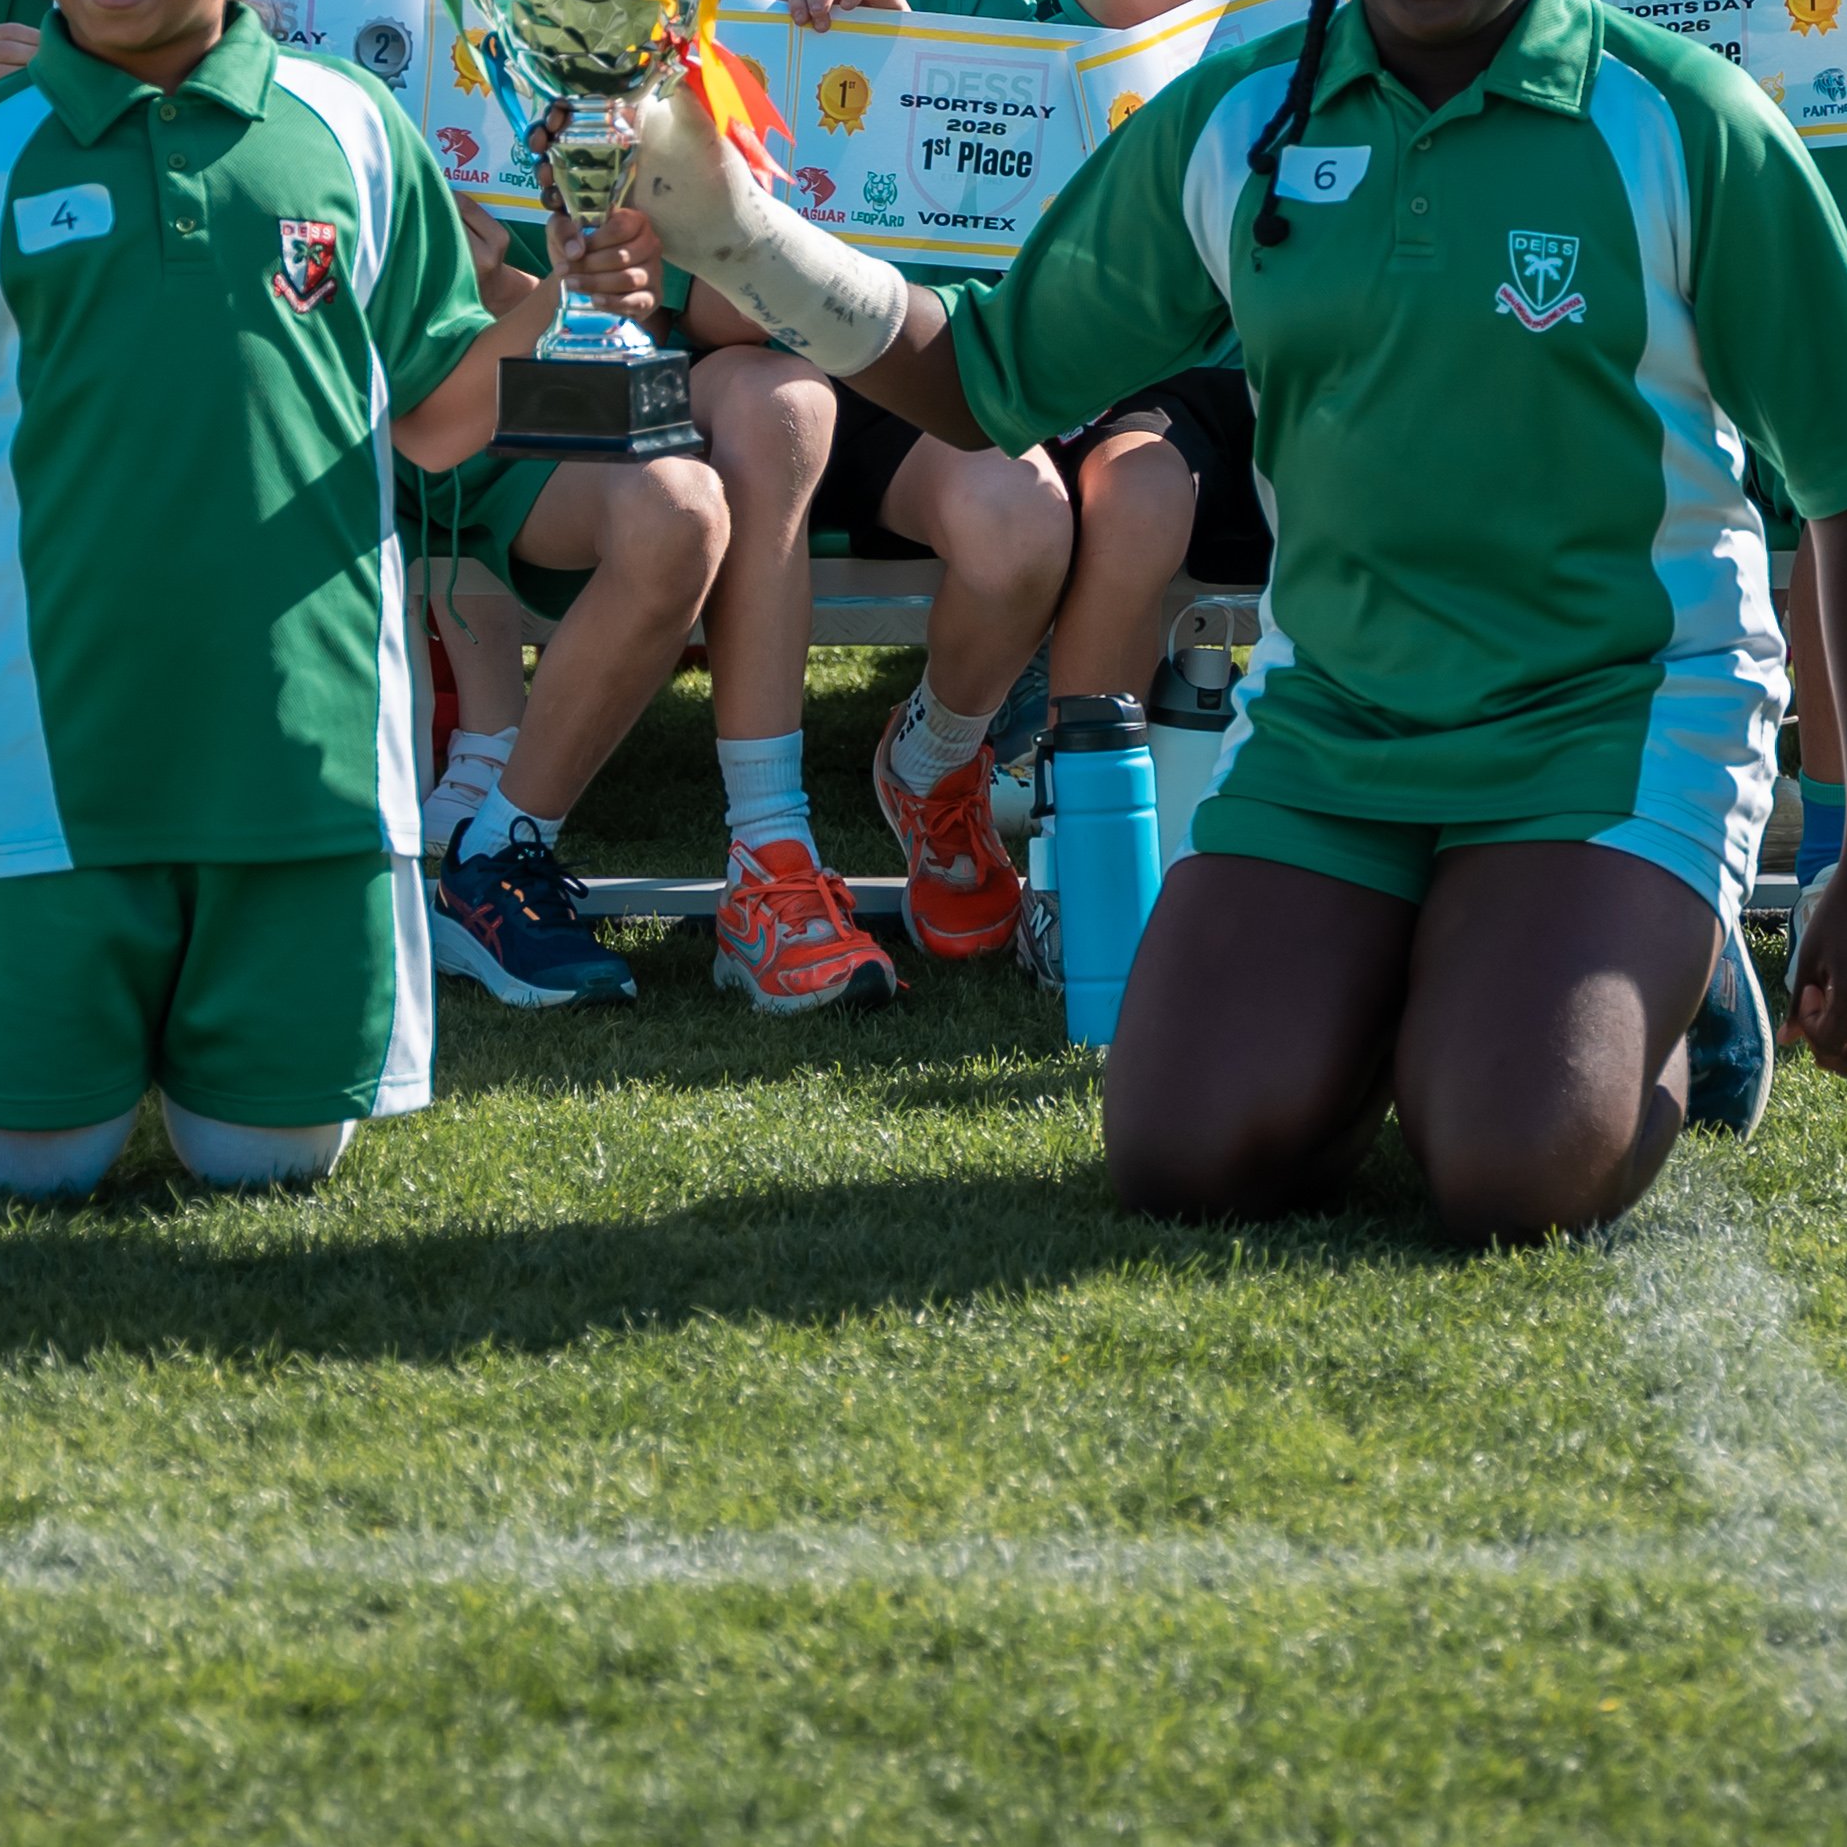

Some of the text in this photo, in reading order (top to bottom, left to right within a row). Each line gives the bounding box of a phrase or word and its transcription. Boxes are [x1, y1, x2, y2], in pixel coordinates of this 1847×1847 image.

[271, 28, 327, 45] DAY
[900, 94, 1056, 120] SPORTS DAY
[946, 118, 1007, 136] 2026
[921, 136, 951, 170] 1st
[957, 140, 1033, 178] Place
[443, 167, 490, 184] AGUAR
[1314, 159, 1337, 190] 6
[51, 199, 78, 230] 4
[851, 210, 905, 227] LEOPARD
[918, 211, 1017, 232] VORTEX
[282, 223, 333, 240] DESS
[1514, 237, 1573, 256] DESS
